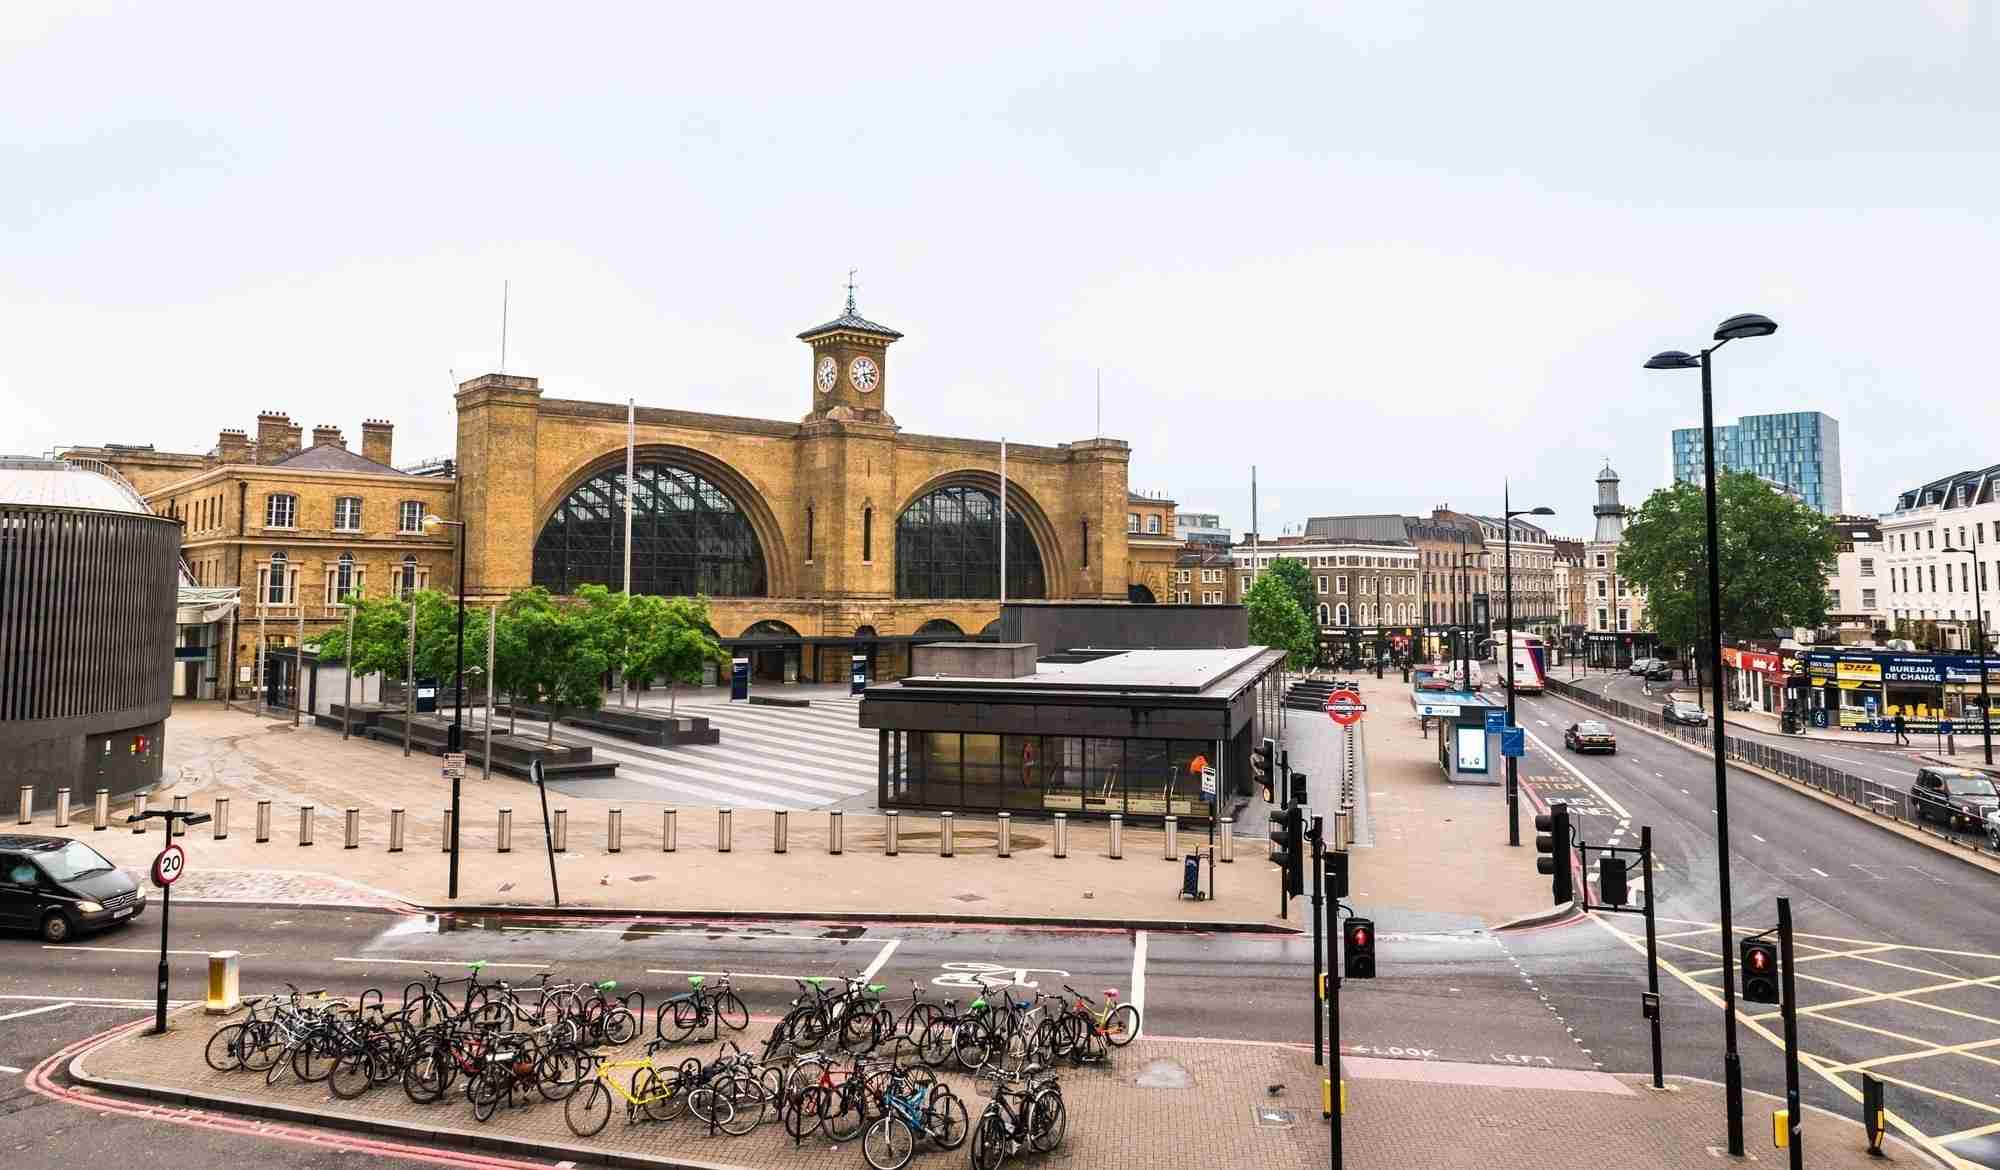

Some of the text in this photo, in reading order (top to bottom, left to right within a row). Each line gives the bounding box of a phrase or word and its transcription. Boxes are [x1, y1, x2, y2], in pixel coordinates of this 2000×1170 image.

[1843, 664, 1873, 672] DHL
[1890, 665, 1935, 674] BUREAUX
[1885, 673, 1898, 681] DE
[1900, 674, 1942, 682] CHANGE
[163, 855, 180, 873] 20
[1373, 1046, 1553, 1064] LOOK LEFT
